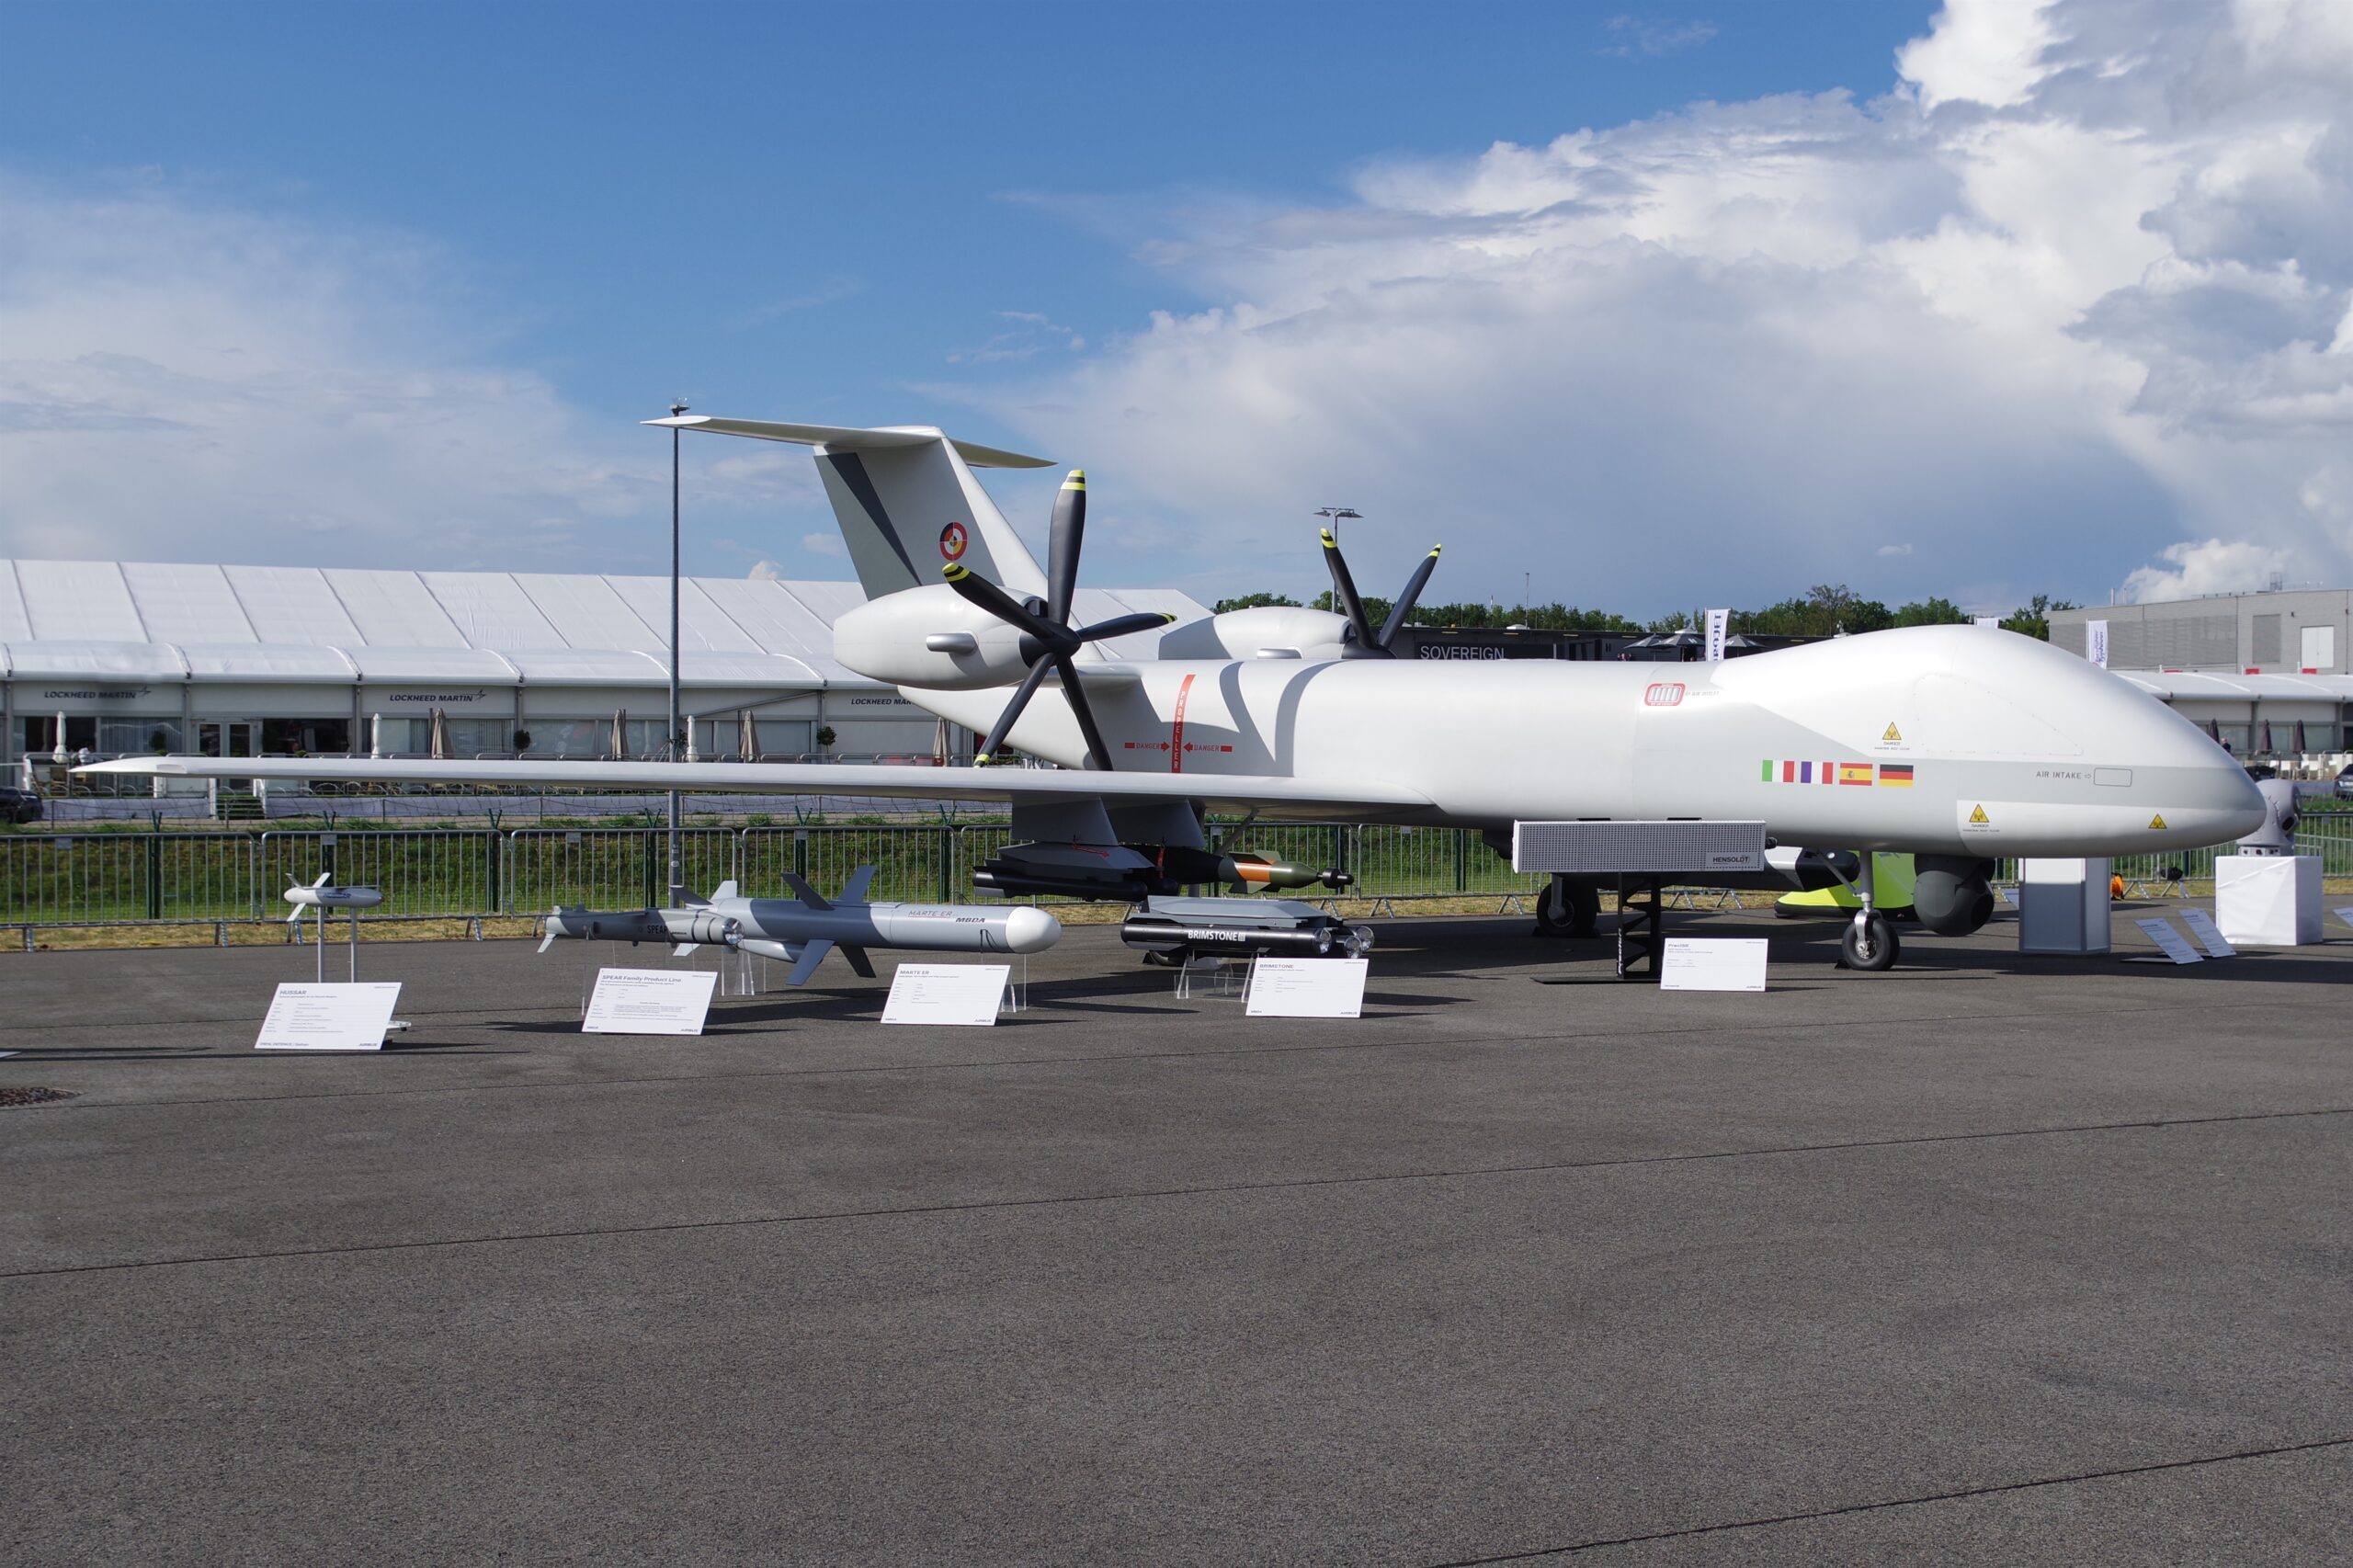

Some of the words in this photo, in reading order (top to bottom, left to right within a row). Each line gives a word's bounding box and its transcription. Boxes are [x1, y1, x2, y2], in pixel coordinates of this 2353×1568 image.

[1420, 645, 1505, 660] SOVEREIGN
[1173, 690, 1186, 769] PROPELLER
[2036, 770, 2050, 778] AIR
[2052, 771, 2082, 779] INTAKE
[1188, 930, 1238, 941] BRIMSTONE
